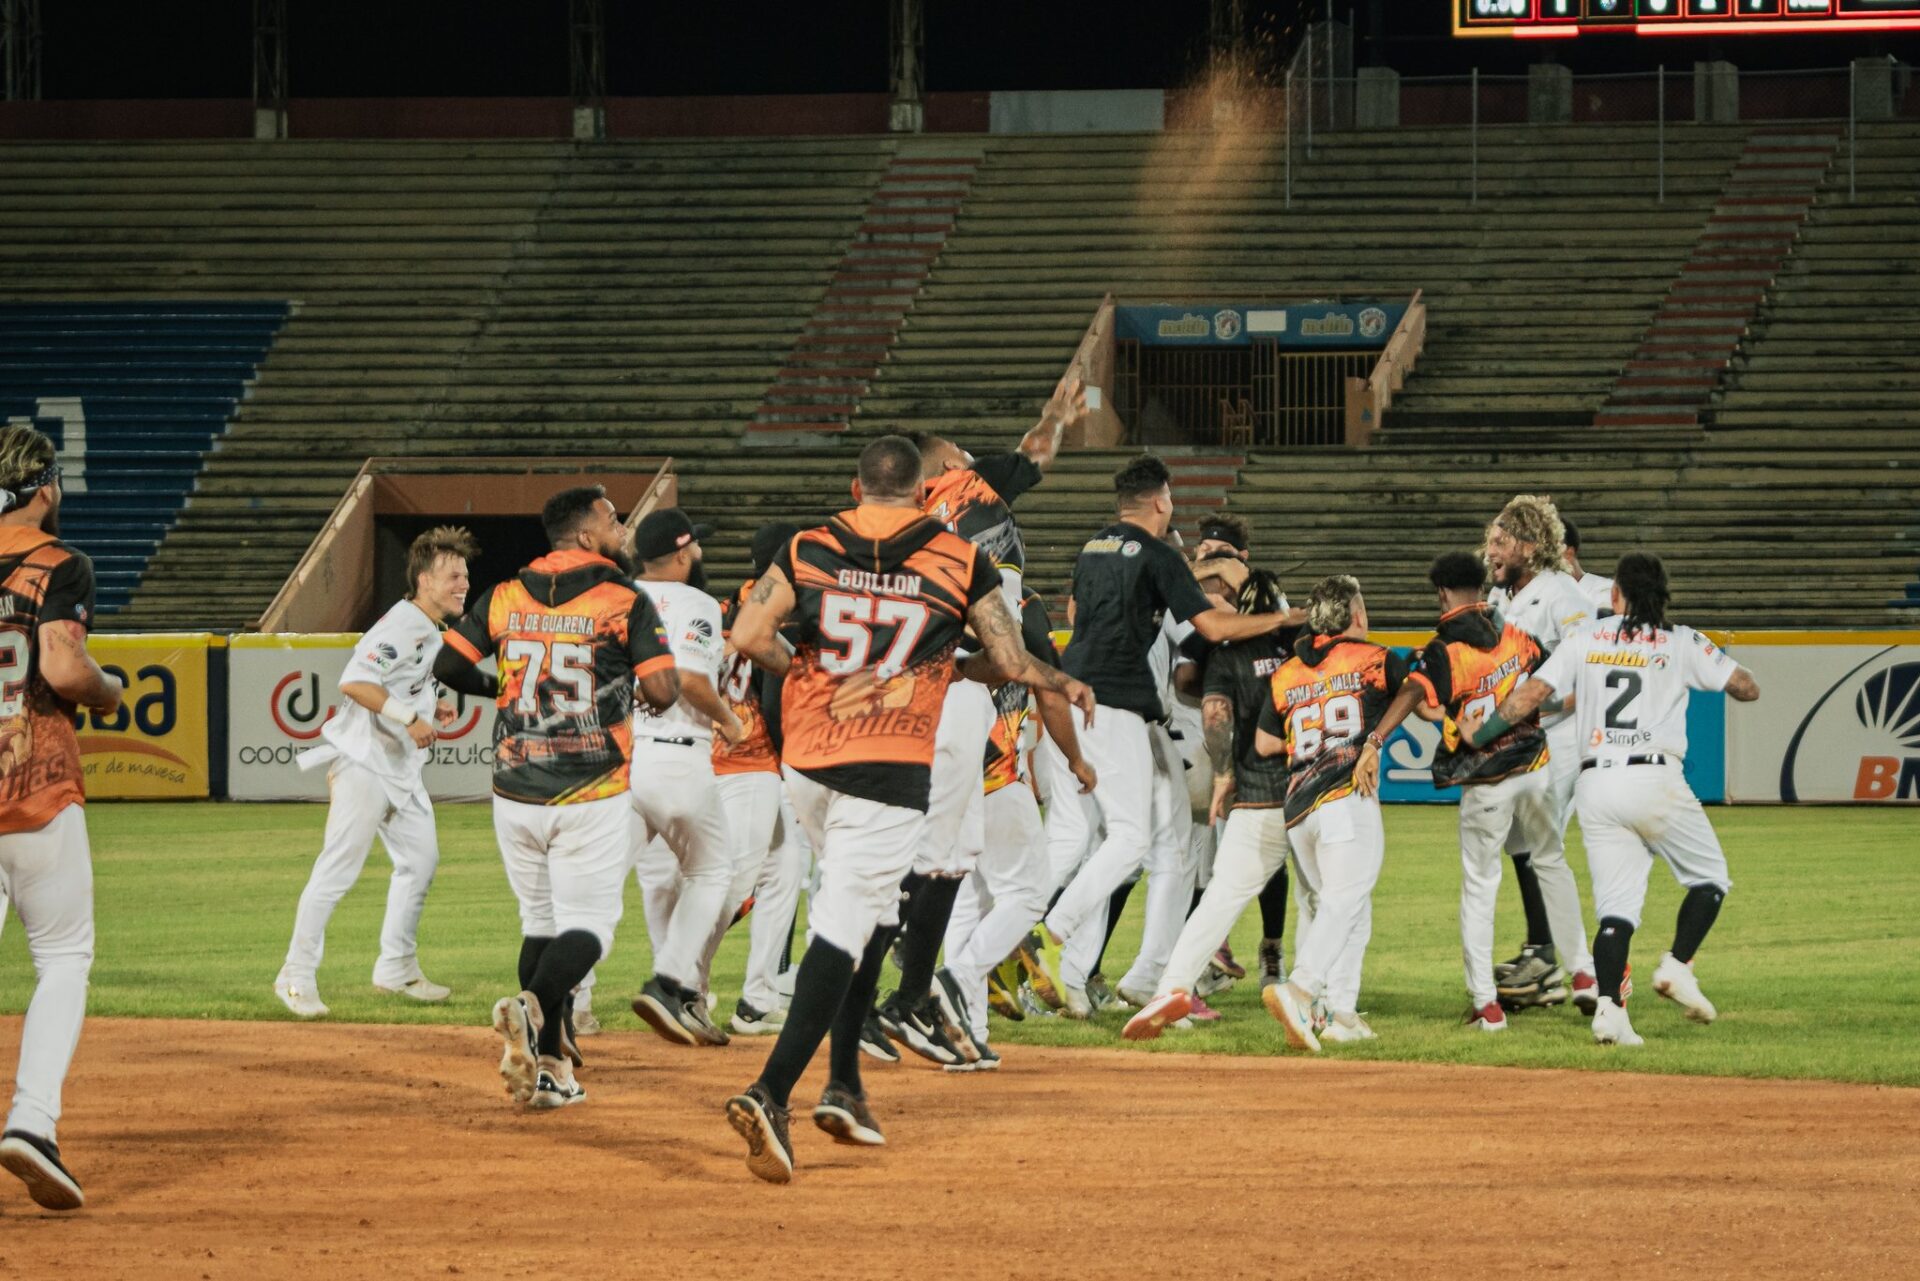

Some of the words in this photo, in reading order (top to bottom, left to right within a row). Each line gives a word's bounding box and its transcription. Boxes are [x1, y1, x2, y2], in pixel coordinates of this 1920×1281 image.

[837, 568, 922, 596] GUILLON
[508, 612, 521, 631] EL
[524, 613, 540, 632] DE
[819, 591, 931, 682] 57
[506, 639, 596, 715] 75
[1605, 669, 1642, 729] 2
[1290, 695, 1364, 761] 69
[105, 757, 125, 774] de
